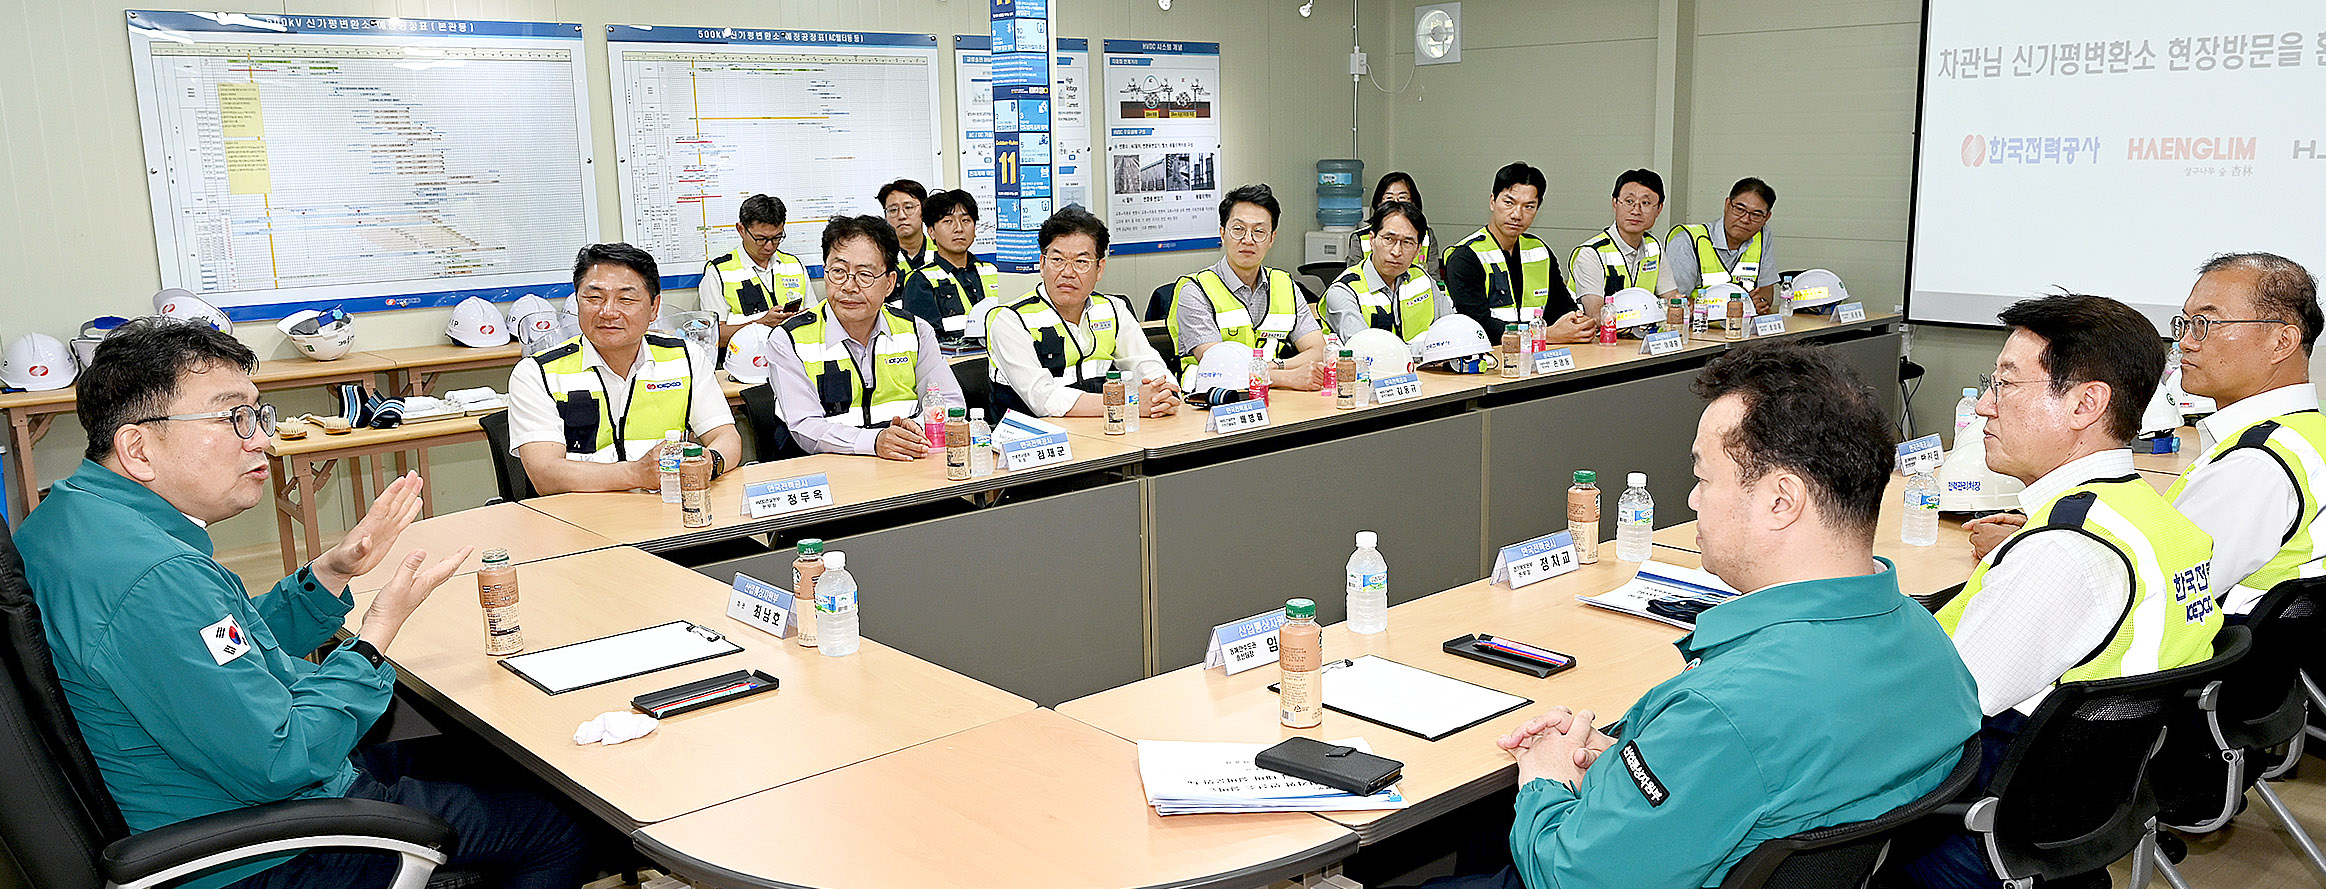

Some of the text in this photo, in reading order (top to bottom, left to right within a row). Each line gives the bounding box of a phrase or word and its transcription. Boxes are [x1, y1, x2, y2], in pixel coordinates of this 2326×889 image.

[1938, 46, 2003, 80] 차관님
[2012, 39, 2157, 77] 신가평변환소
[2168, 31, 2304, 72] 현장방문을
[1989, 136, 2100, 165] 한국전력공사
[2127, 137, 2257, 160] HAENGLIM
[998, 151, 1017, 185] 11
[766, 479, 809, 493] 한국전력공사
[787, 489, 823, 506] 정두옥
[1520, 538, 1557, 556] 한국전력공사
[1540, 551, 1571, 572] 정치교
[753, 604, 781, 627] 최남호
[1238, 614, 1286, 637] 산업통상자원
[1266, 635, 1279, 652] 임
